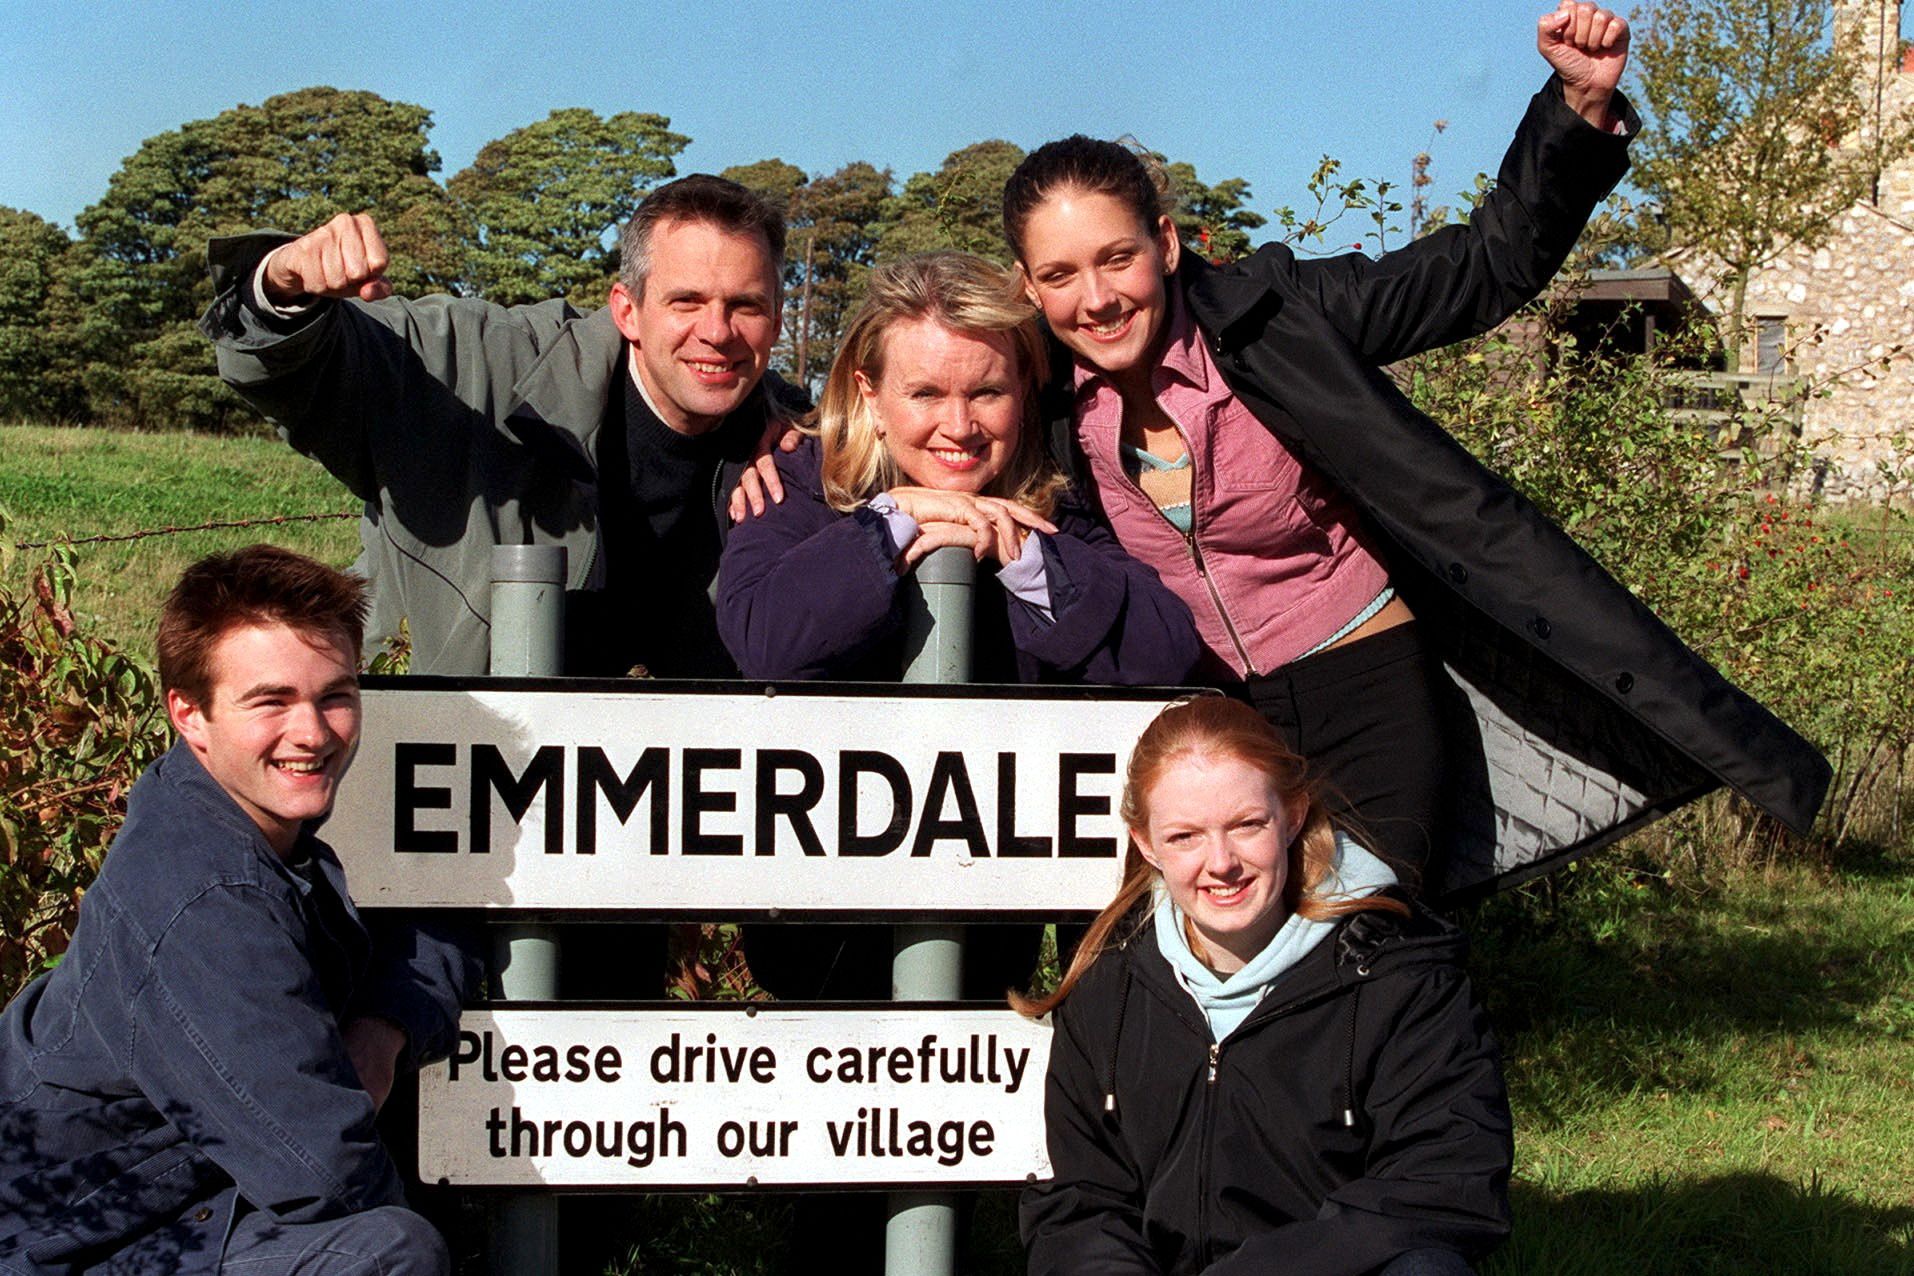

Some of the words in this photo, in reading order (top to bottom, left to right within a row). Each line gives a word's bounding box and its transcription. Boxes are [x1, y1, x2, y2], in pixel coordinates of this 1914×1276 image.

[395, 742, 1117, 858] EMMERDALE
[448, 1030, 623, 1083] Please
[649, 1033, 777, 1084] drive
[805, 1034, 1031, 1093] carefully
[486, 1107, 687, 1167] through
[717, 1118, 798, 1157] our
[827, 1107, 995, 1166] village
